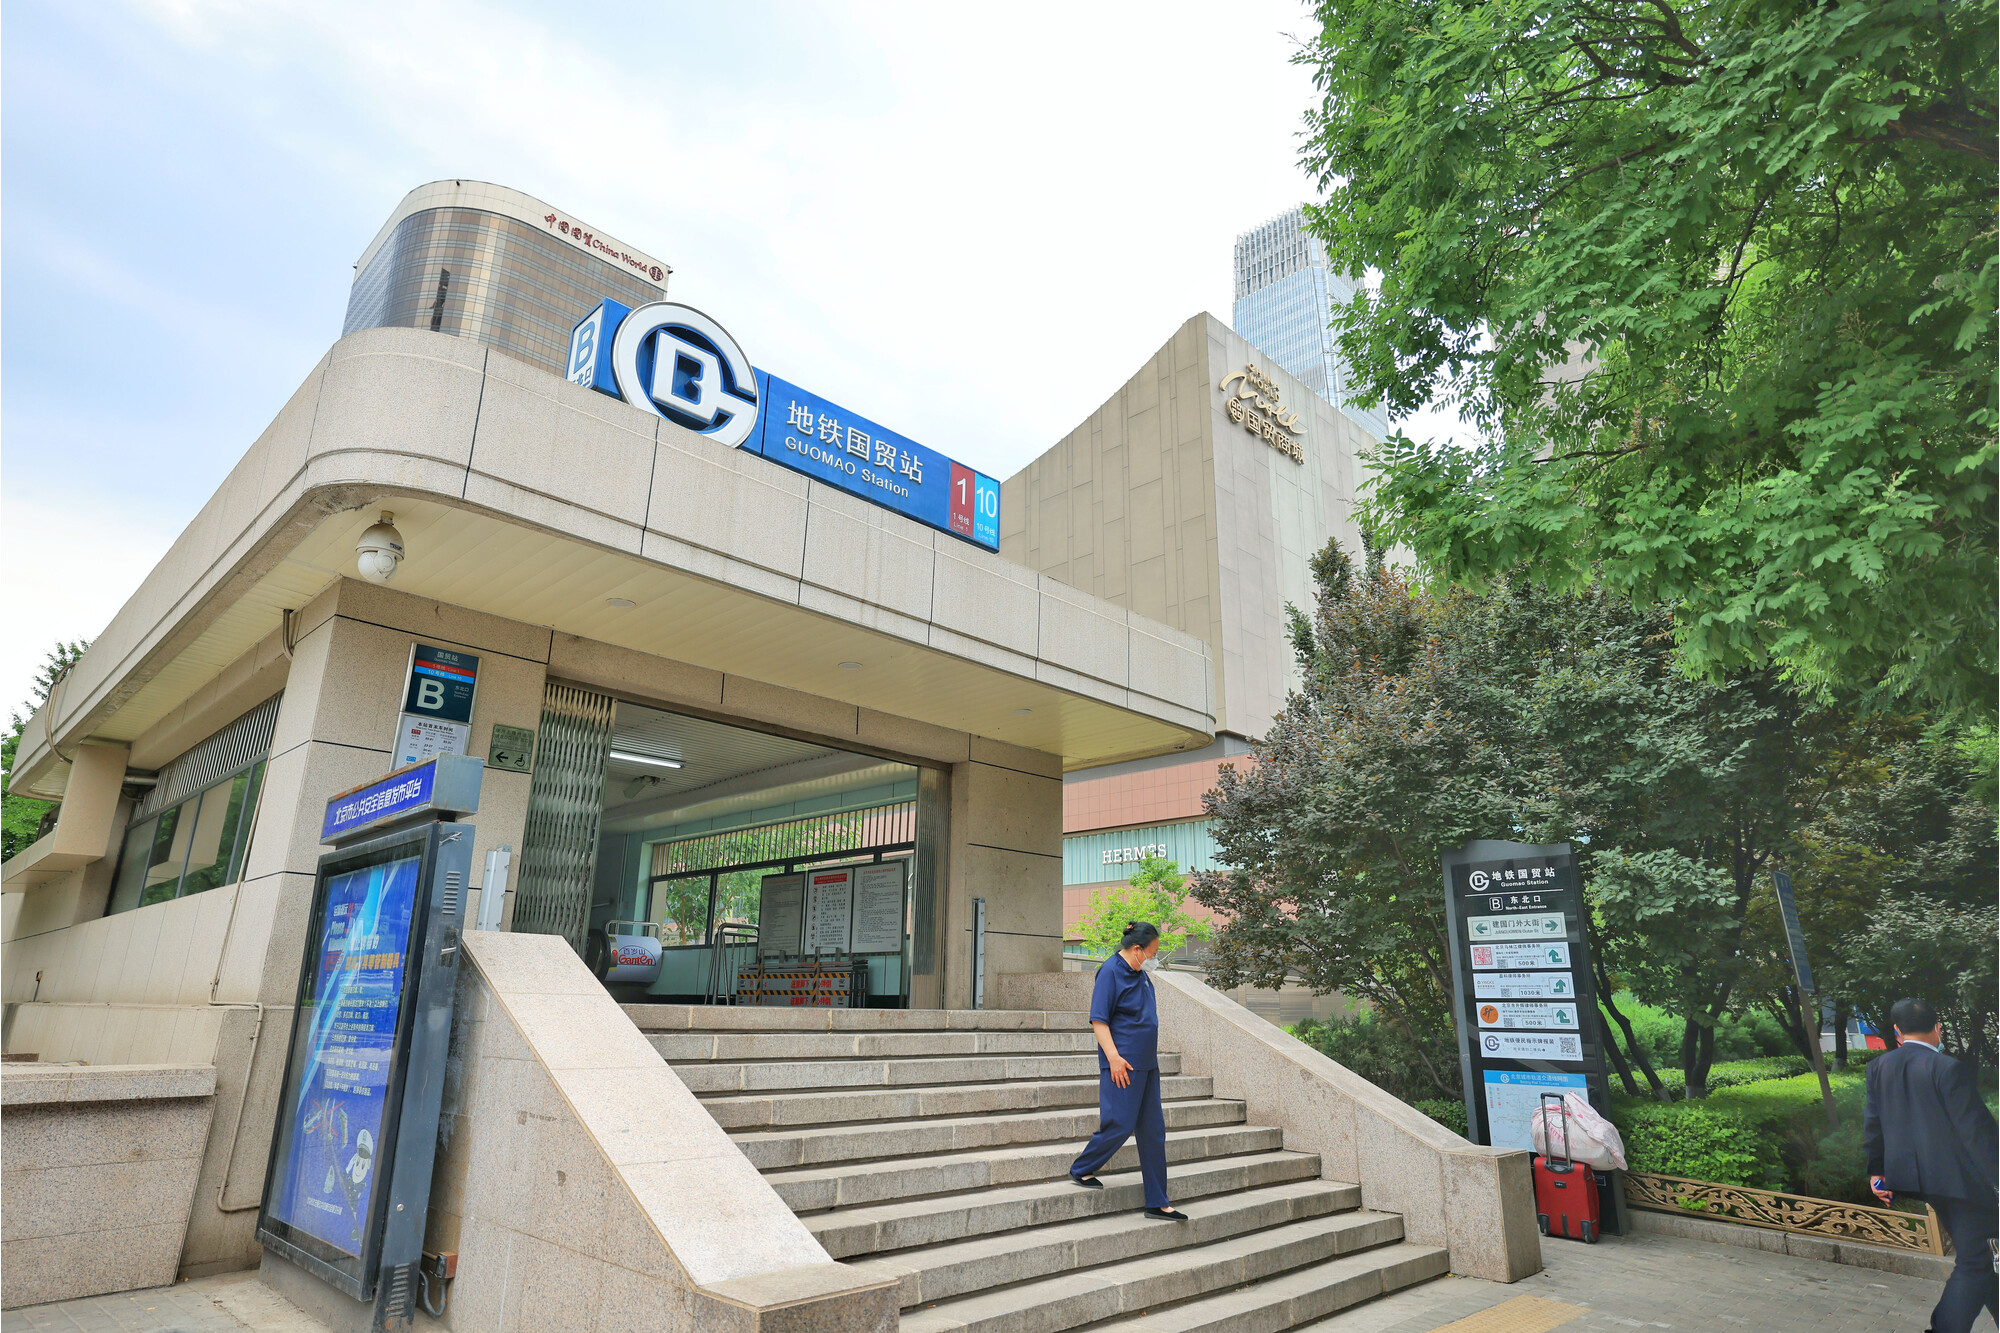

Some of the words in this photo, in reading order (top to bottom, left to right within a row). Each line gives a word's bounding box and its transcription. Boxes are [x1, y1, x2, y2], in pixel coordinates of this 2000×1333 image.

[592, 239, 620, 259] China
[620, 252, 648, 273] World
[573, 320, 596, 374] B
[1247, 362, 1280, 392] CHINA
[1247, 373, 1280, 403] WORLD
[1219, 371, 1308, 436] Mall
[786, 399, 924, 486] 地铁国贸站
[1245, 407, 1305, 466] 国贸商城
[784, 436, 856, 476] GUOMAO
[860, 467, 910, 499] Station
[956, 477, 967, 506] 1
[976, 486, 997, 518] 10
[436, 651, 459, 662] 国贸站
[416, 678, 445, 710] B
[333, 778, 423, 826] 北京市公共安全信息发布平台
[1491, 866, 1556, 881] 地铁国贸站
[1492, 898, 1501, 909] B
[1510, 895, 1541, 904] 东北口
[1492, 918, 1540, 928] 建国门外大街
[624, 948, 646, 956] 百岁山
